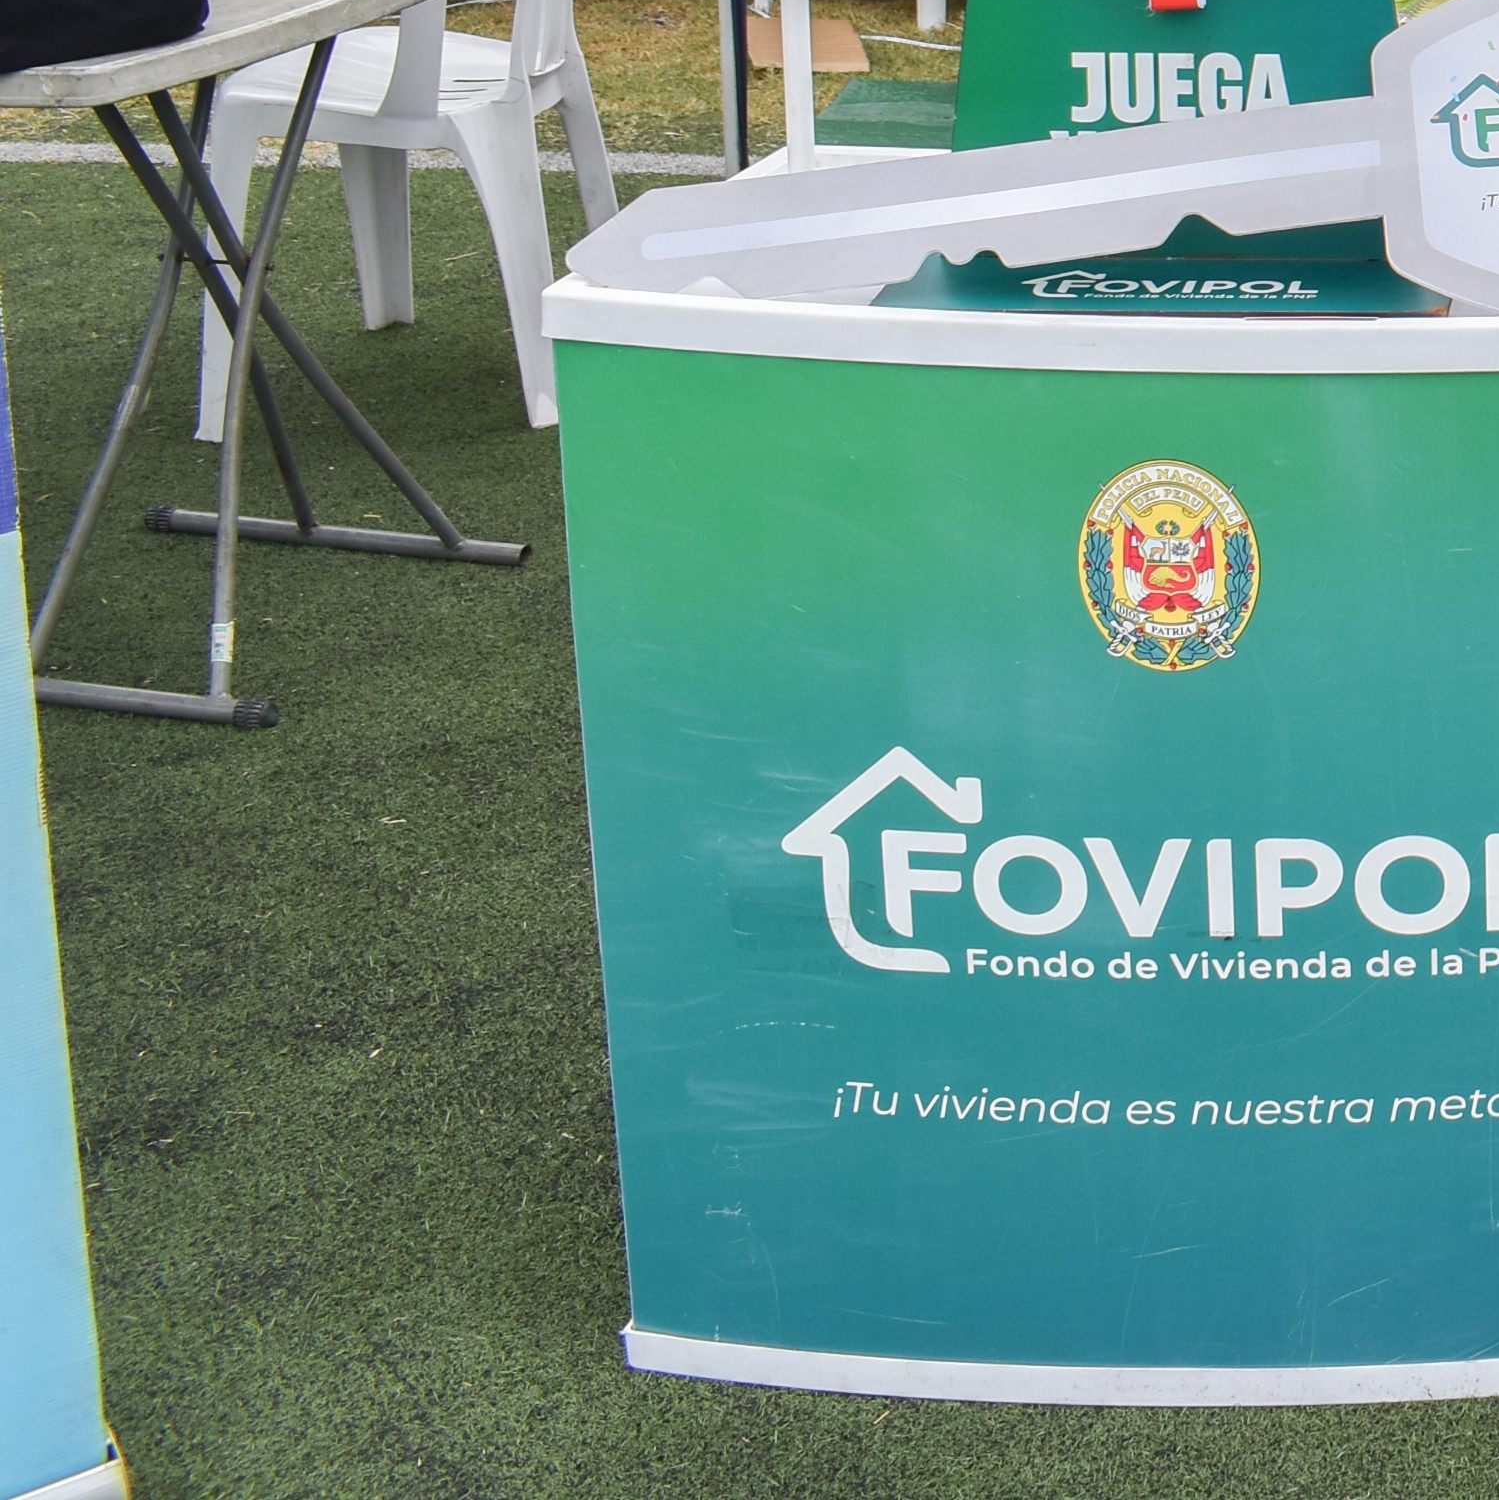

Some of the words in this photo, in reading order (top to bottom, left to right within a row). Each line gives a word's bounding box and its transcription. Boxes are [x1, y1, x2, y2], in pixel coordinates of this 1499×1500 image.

[1071, 51, 1290, 124] JUEGA
[1057, 279, 1319, 295] FOVIPOL
[1096, 471, 1152, 520] POLICIA
[1155, 468, 1239, 521] NACIONAL
[1133, 489, 1160, 509] DEL
[1163, 488, 1202, 509] PERU
[1117, 605, 1142, 622] DIOS
[1151, 624, 1194, 636] PATRIA
[1201, 606, 1224, 622] LEY
[966, 948, 1096, 980] Fondo
[1107, 948, 1159, 980] de
[1171, 951, 1353, 980] Vivienda
[1365, 947, 1417, 979] de
[1430, 946, 1463, 976] la
[832, 1080, 899, 1119] ¡Tu
[913, 1084, 1112, 1126] vivienda
[1126, 1099, 1177, 1126] es
[1191, 1093, 1374, 1126] nuestra
